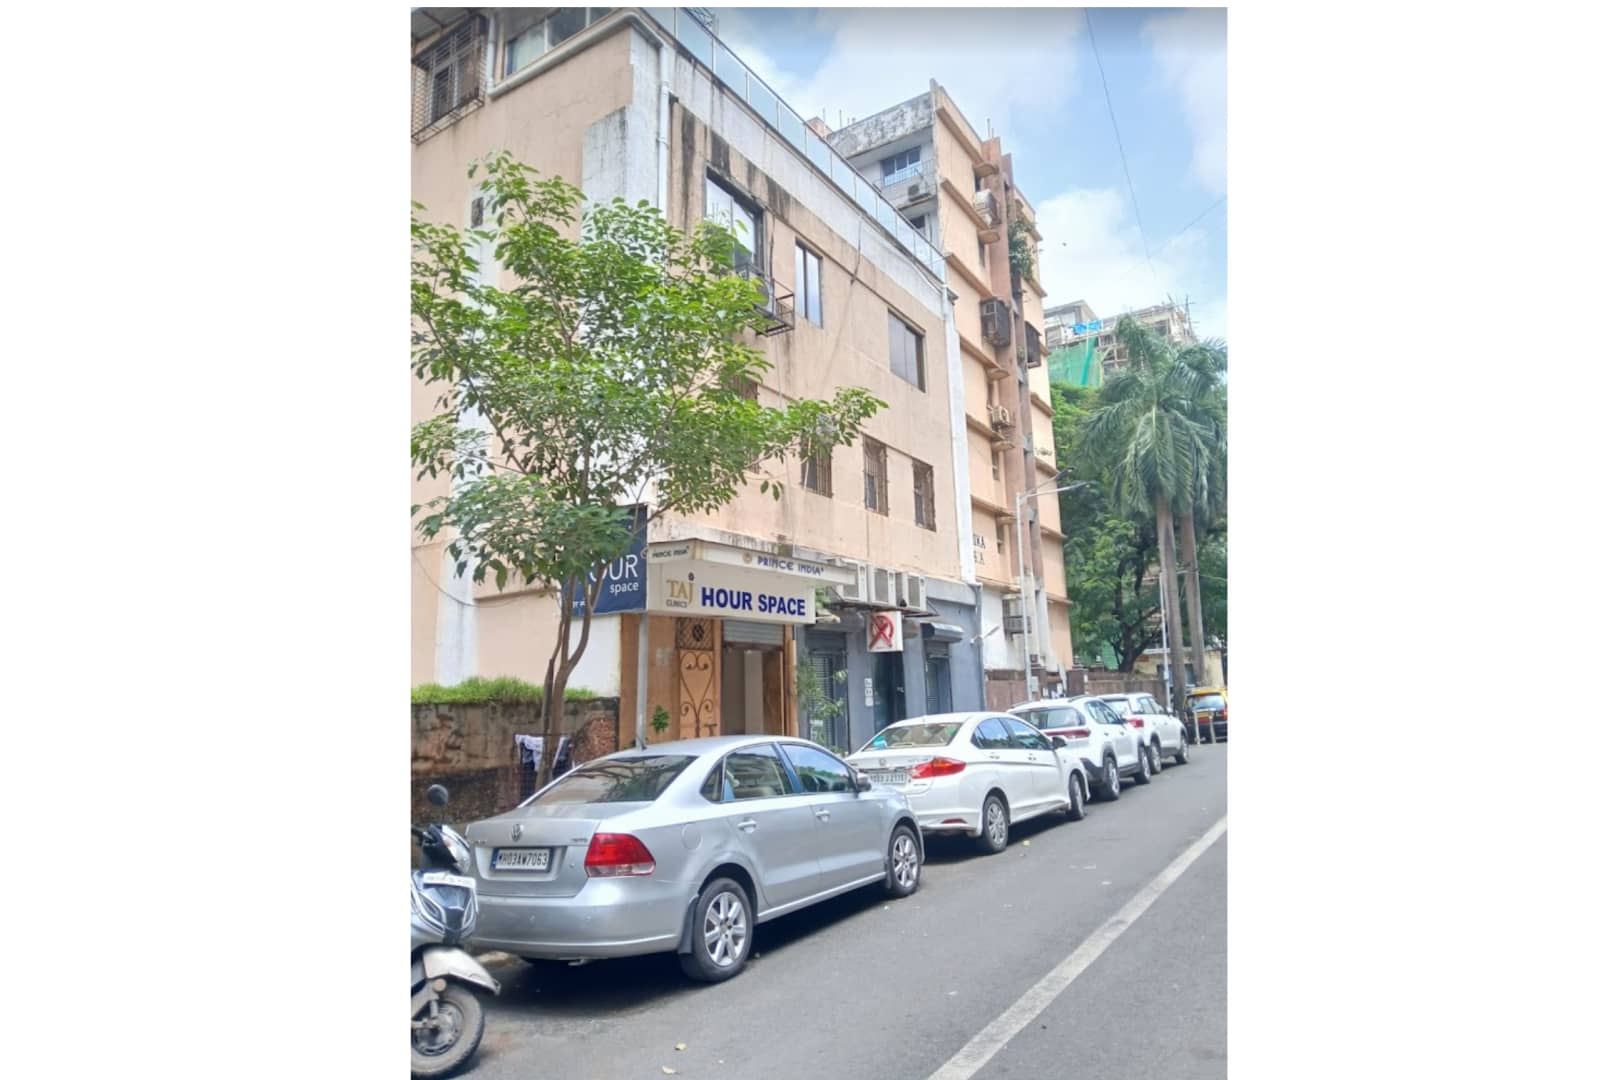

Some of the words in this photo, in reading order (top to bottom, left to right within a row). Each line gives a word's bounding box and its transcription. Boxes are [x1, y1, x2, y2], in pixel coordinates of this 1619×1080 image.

[757, 555, 794, 571] PRINCE
[609, 582, 639, 596] space
[701, 586, 753, 611] HOUR
[758, 593, 806, 616] SPACE
